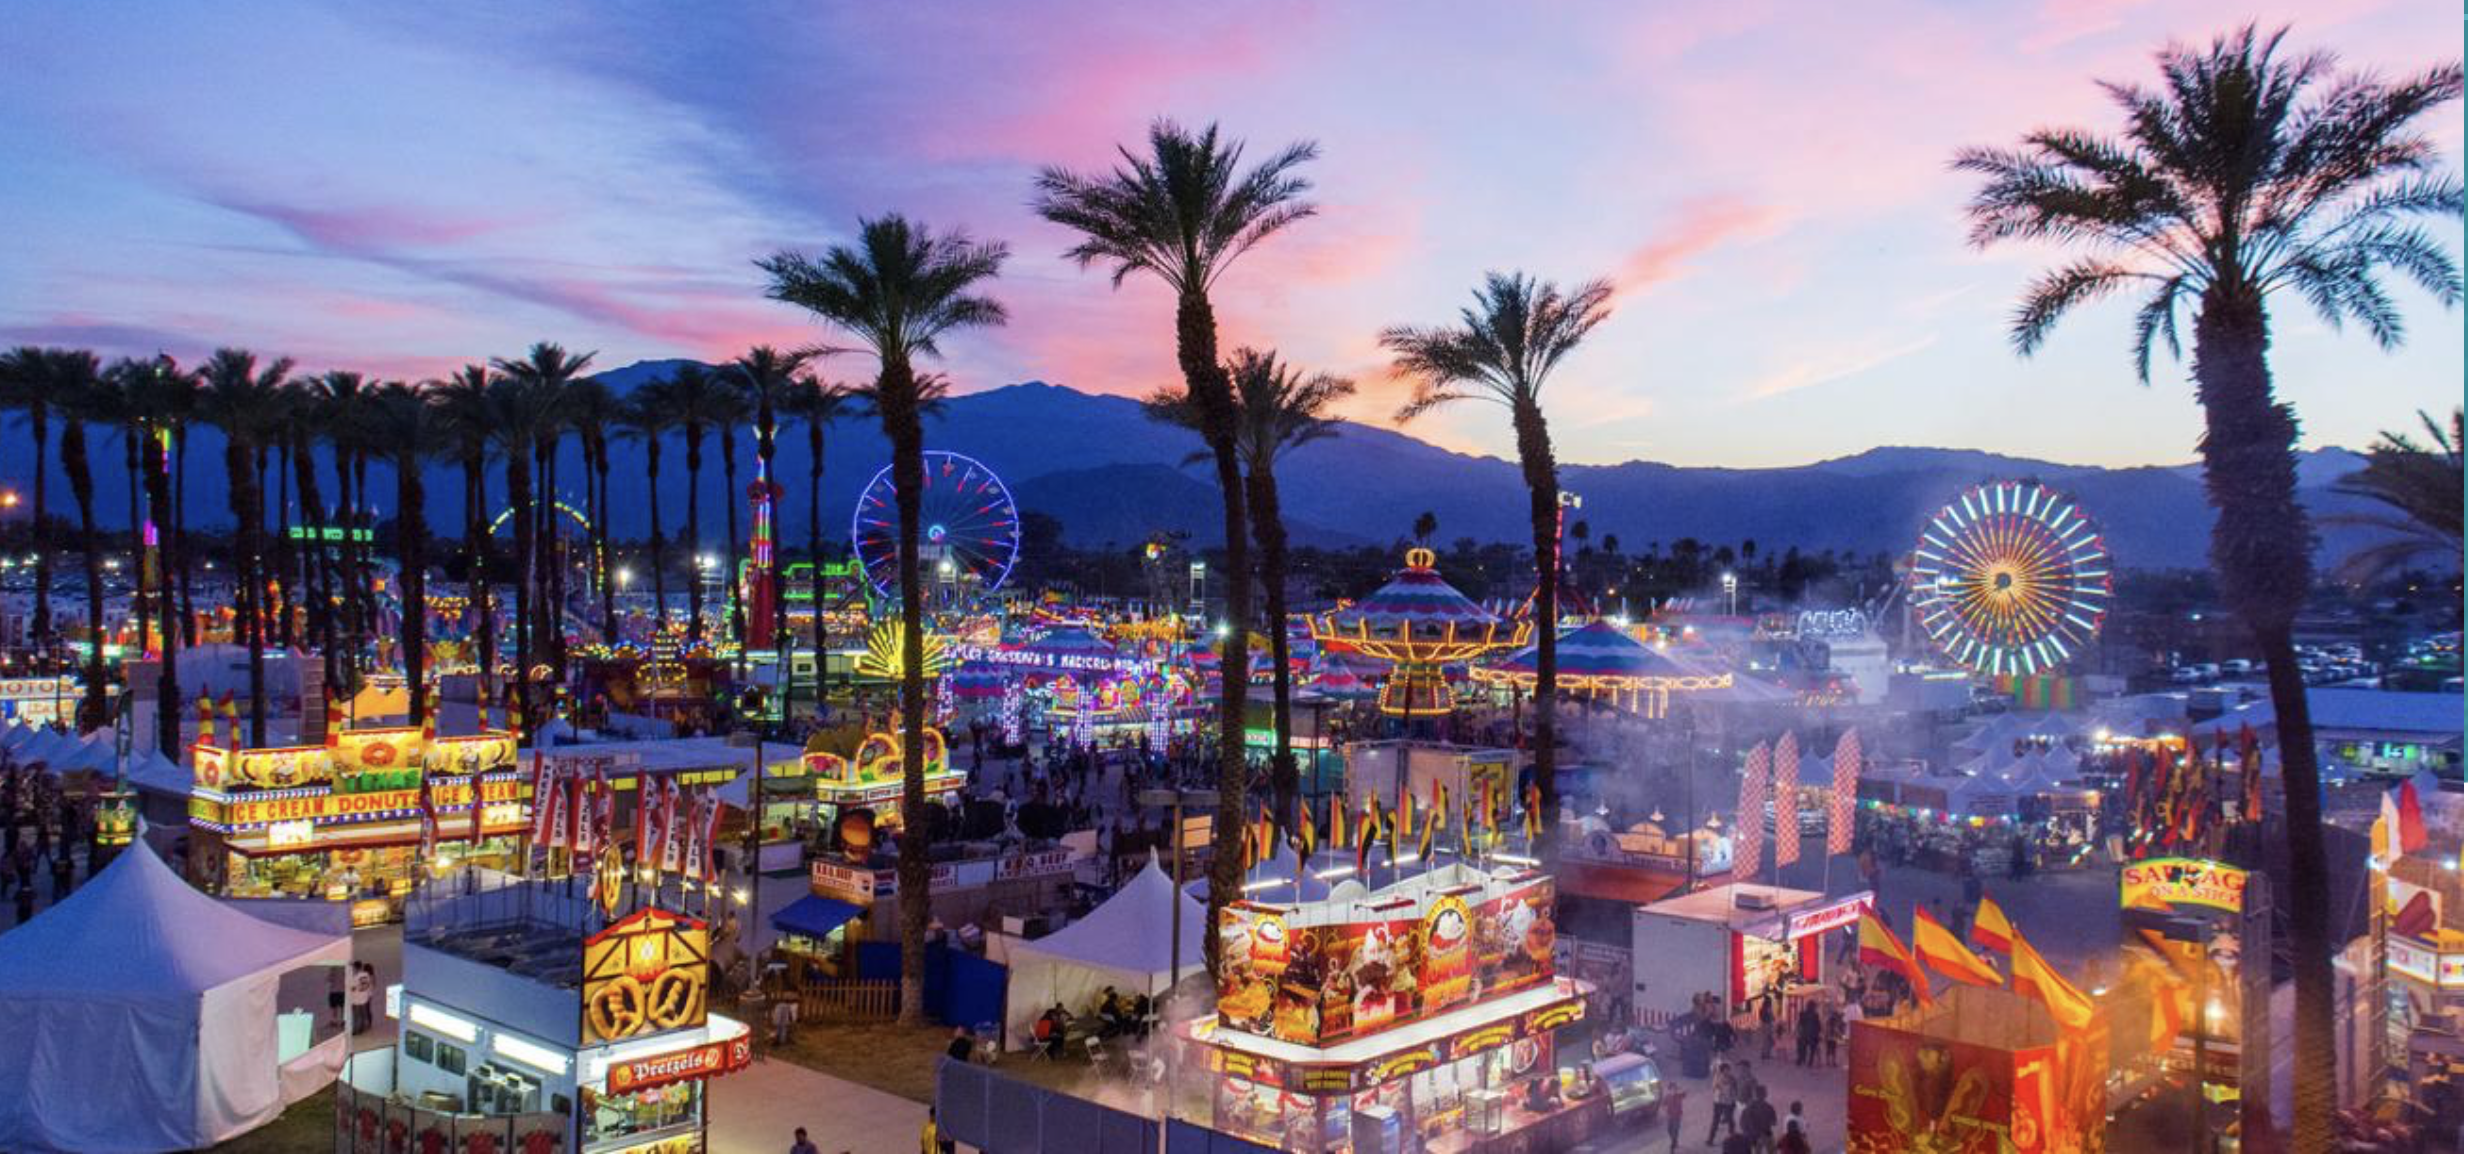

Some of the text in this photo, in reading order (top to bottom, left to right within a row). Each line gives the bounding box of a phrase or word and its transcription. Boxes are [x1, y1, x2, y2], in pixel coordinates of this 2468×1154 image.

[338, 791, 421, 813] DONUTS
[436, 786, 460, 803] ICE
[229, 804, 257, 821] ICE
[267, 798, 324, 819] CREAM
[633, 1050, 703, 1081] Pretzels
